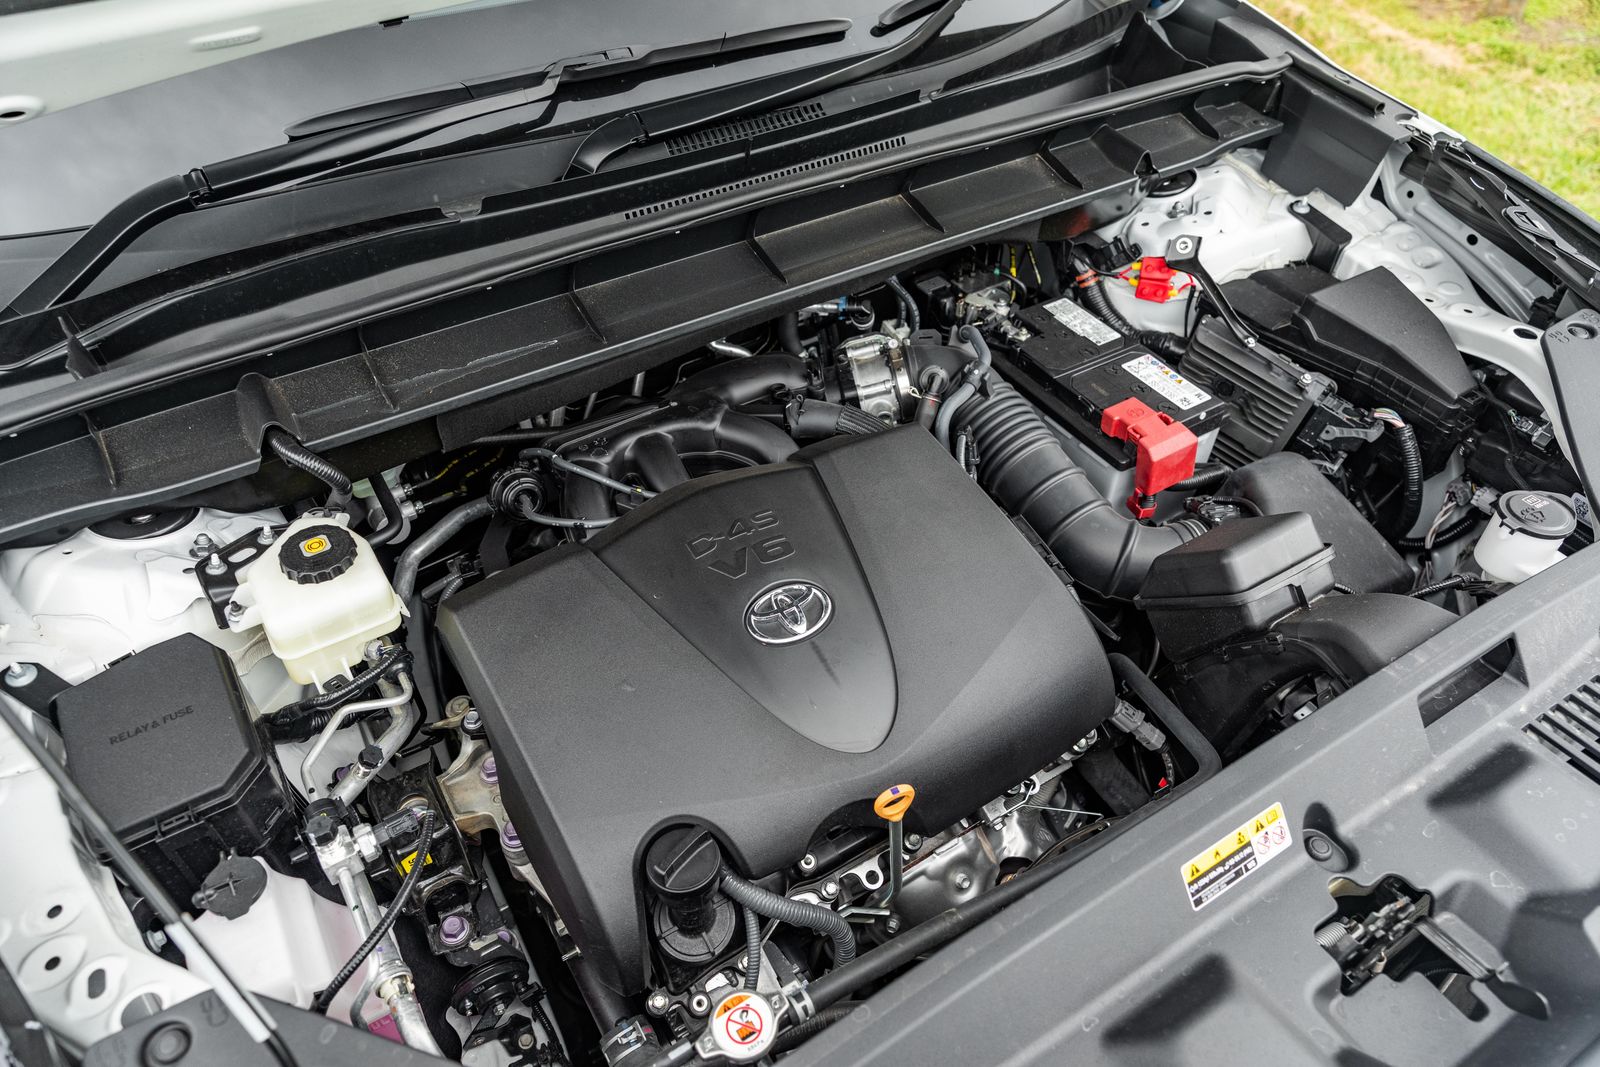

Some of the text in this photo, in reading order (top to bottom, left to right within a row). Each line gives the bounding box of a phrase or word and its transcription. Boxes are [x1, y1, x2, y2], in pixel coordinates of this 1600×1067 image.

[685, 508, 780, 560] D-4S
[706, 535, 797, 580] V6
[109, 705, 194, 745] RELAY & FUSE
